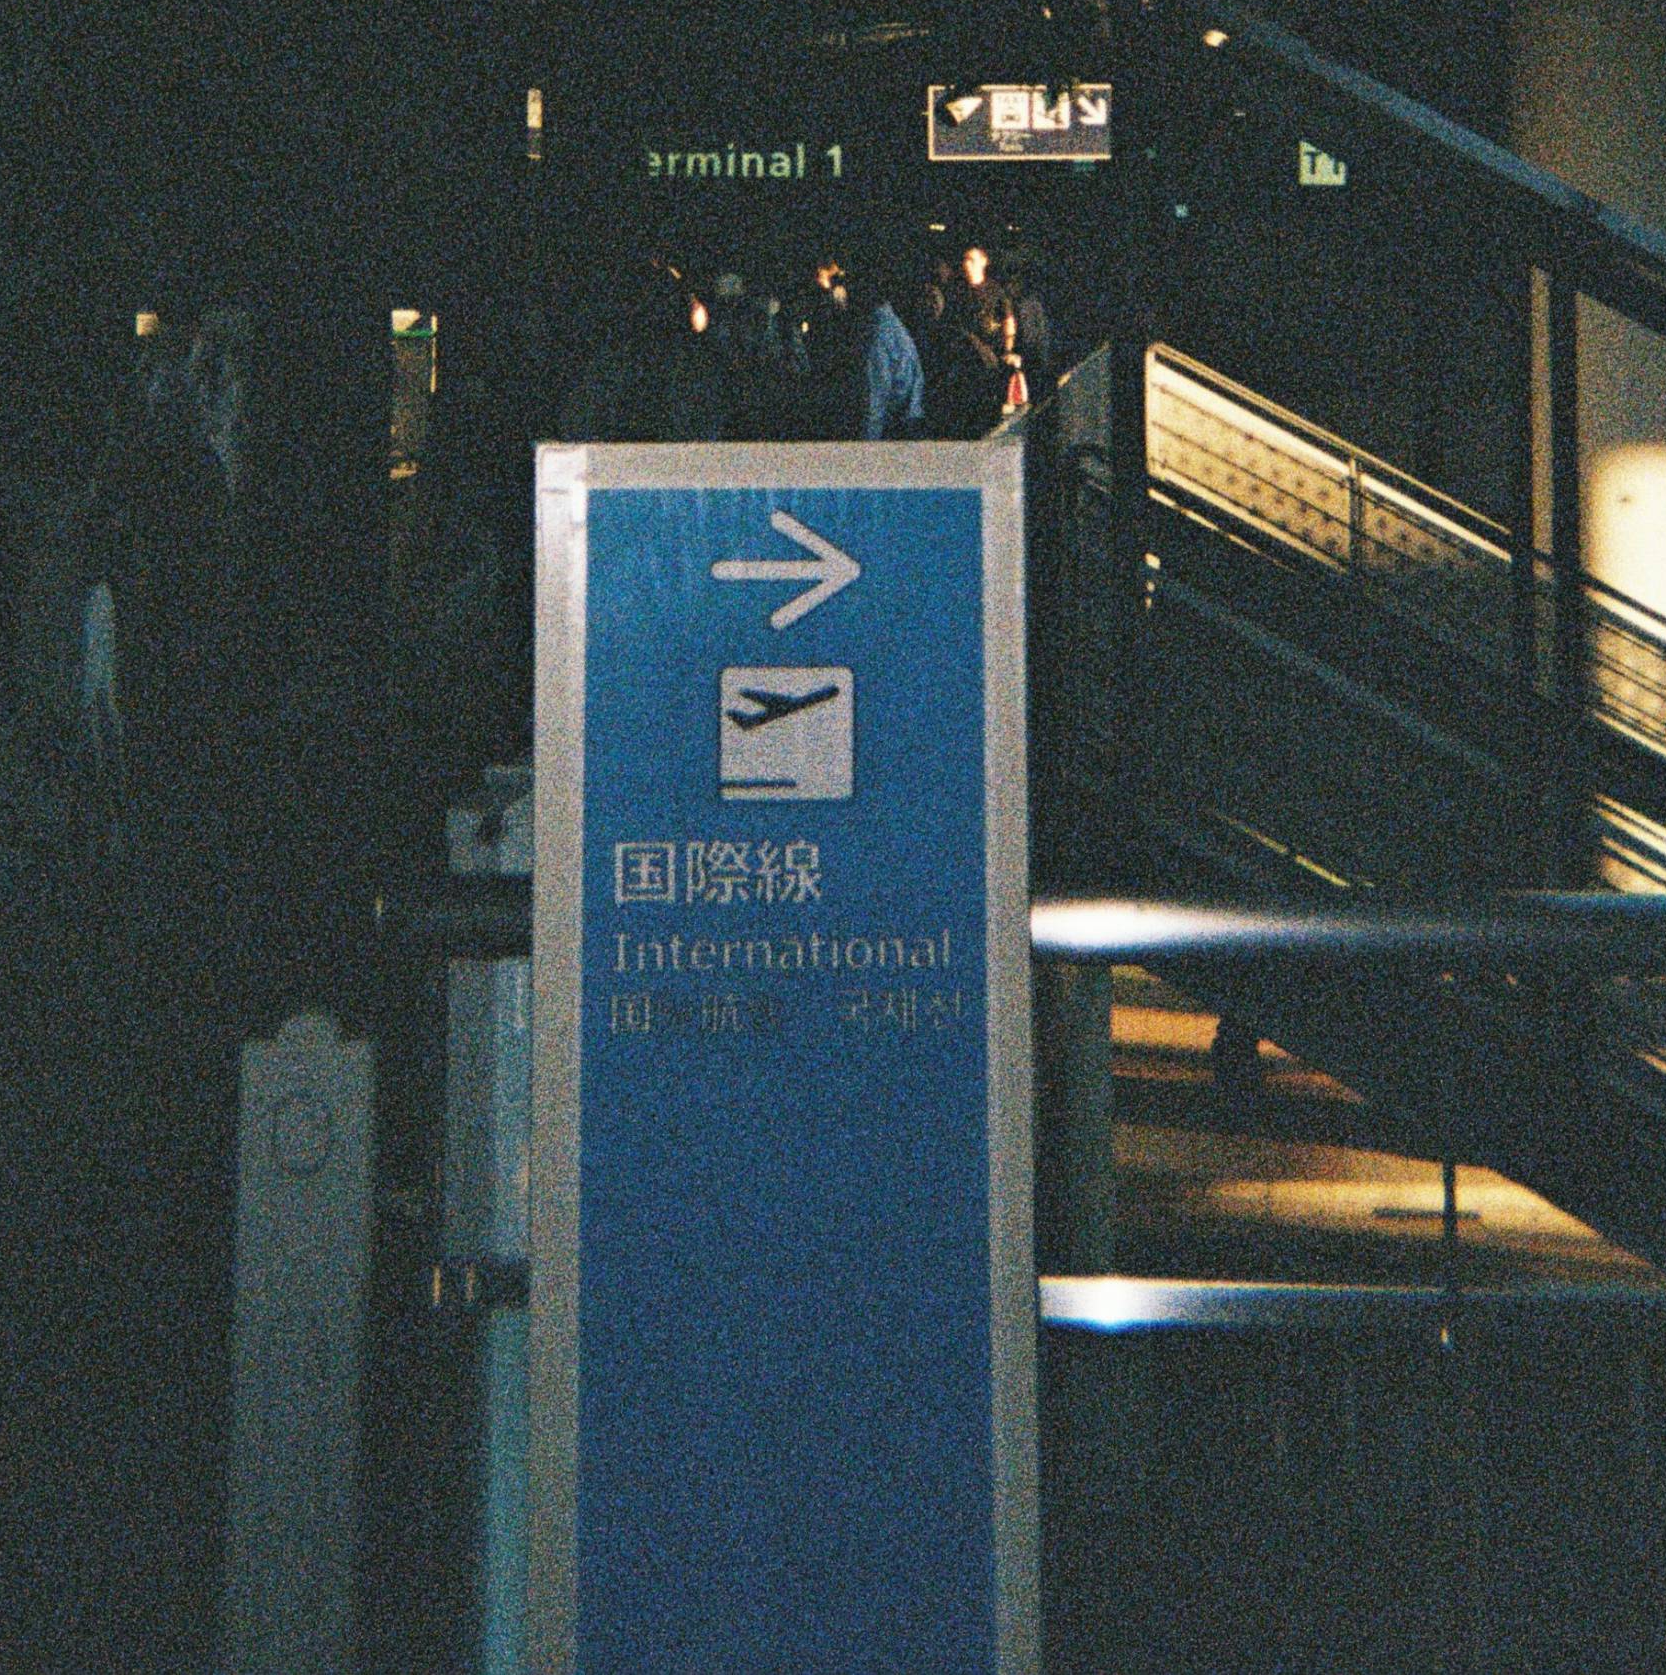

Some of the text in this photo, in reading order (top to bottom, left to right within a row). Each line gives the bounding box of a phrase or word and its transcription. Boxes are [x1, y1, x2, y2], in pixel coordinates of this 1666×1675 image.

[648, 143, 842, 178] erminal 1
[615, 840, 823, 904] 国際線
[614, 928, 951, 972] International
